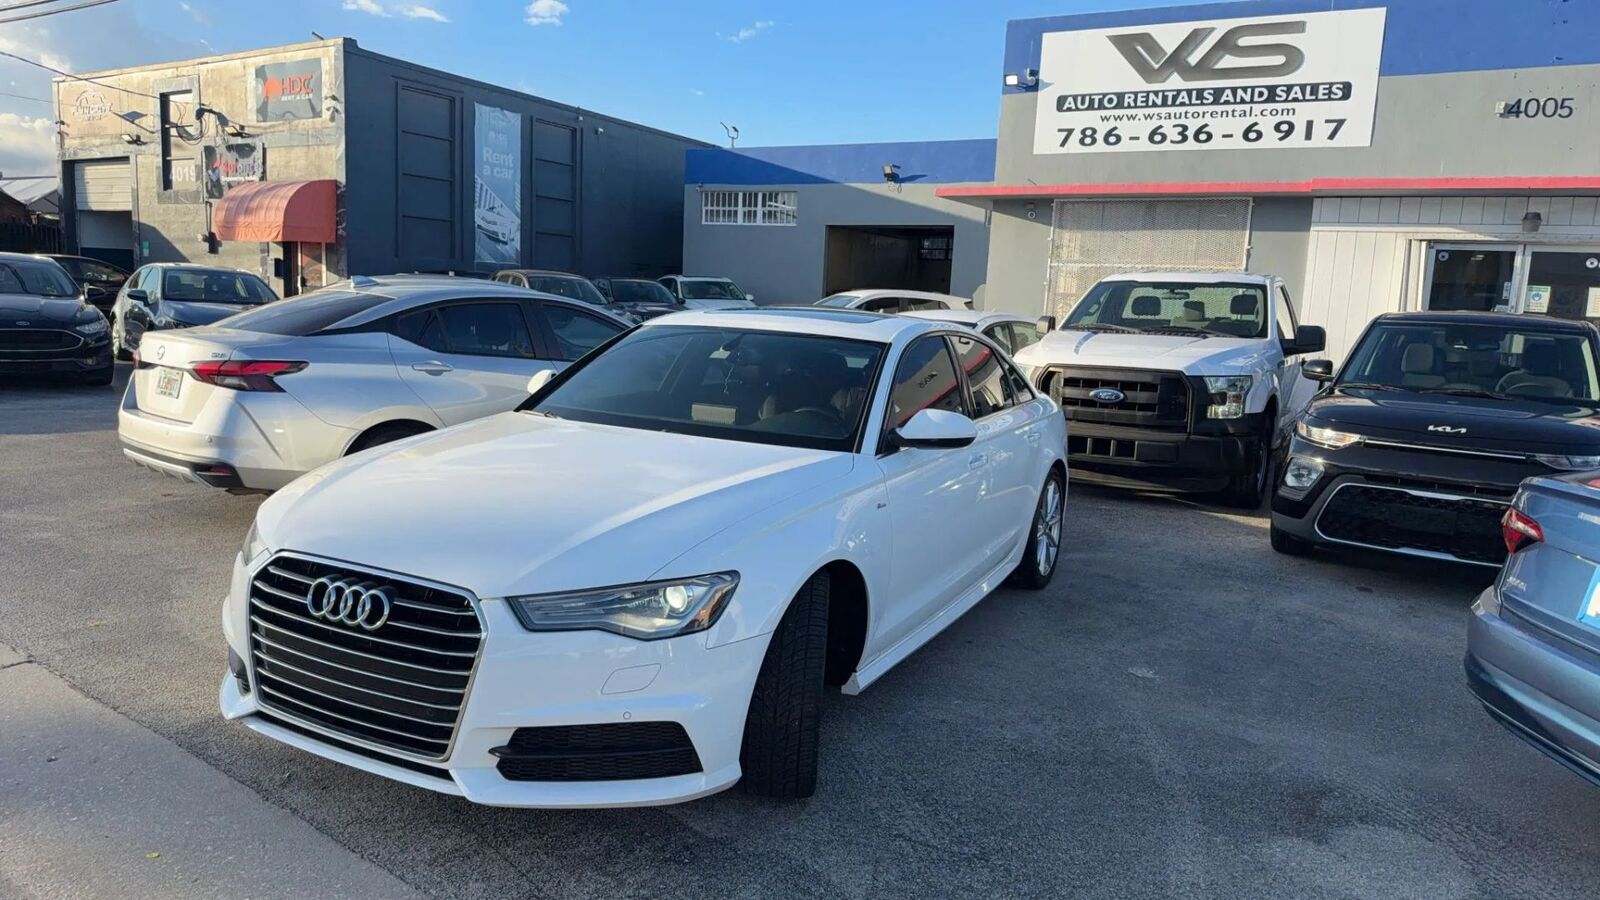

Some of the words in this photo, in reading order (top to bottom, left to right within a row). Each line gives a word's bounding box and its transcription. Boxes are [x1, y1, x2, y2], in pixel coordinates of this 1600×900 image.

[281, 73, 313, 96] HDC
[1062, 94, 1117, 110] AUTO
[1124, 89, 1214, 107] RENTALS
[1219, 87, 1268, 103] AND
[1275, 84, 1344, 101] SALES
[1507, 97, 1574, 118] 4005
[1100, 106, 1296, 122] www.wsautorental.com
[1057, 118, 1347, 148] 786-636-6917
[483, 147, 514, 168] Rent
[483, 165, 490, 176] a
[493, 167, 514, 178] car
